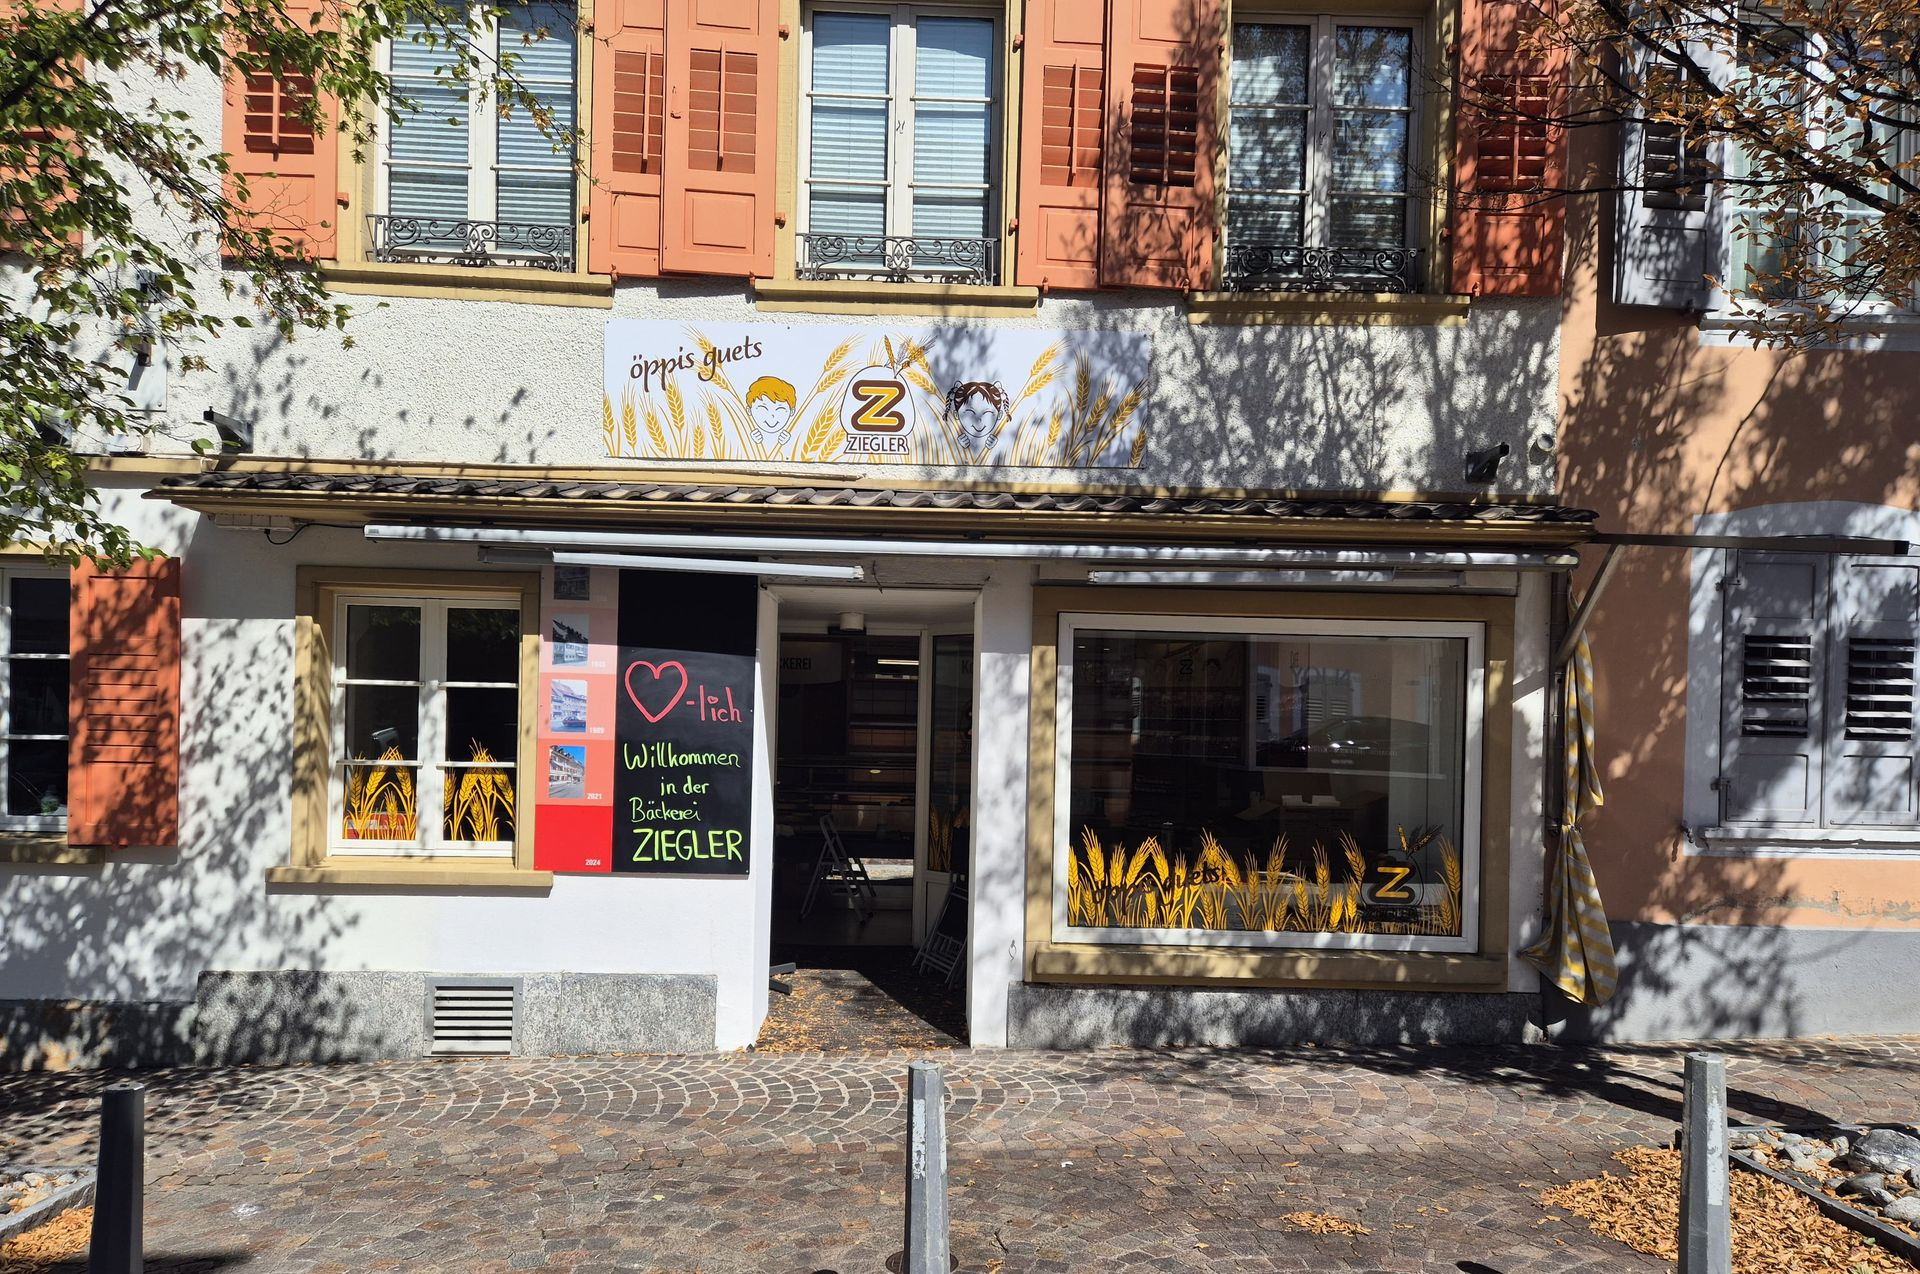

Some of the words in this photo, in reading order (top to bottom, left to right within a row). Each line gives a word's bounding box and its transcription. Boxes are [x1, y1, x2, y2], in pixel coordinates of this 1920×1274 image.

[630, 346, 695, 393] öppis
[697, 335, 763, 382] guets
[851, 380, 906, 433] Z
[848, 436, 907, 453] ZIEGLER
[623, 741, 742, 771] Willkommen
[587, 792, 603, 800] 2021
[660, 776, 678, 797] in
[682, 775, 710, 795] der
[628, 796, 702, 823] Bäckerei
[632, 828, 744, 863] ZIEGLER
[584, 858, 602, 867] 2024
